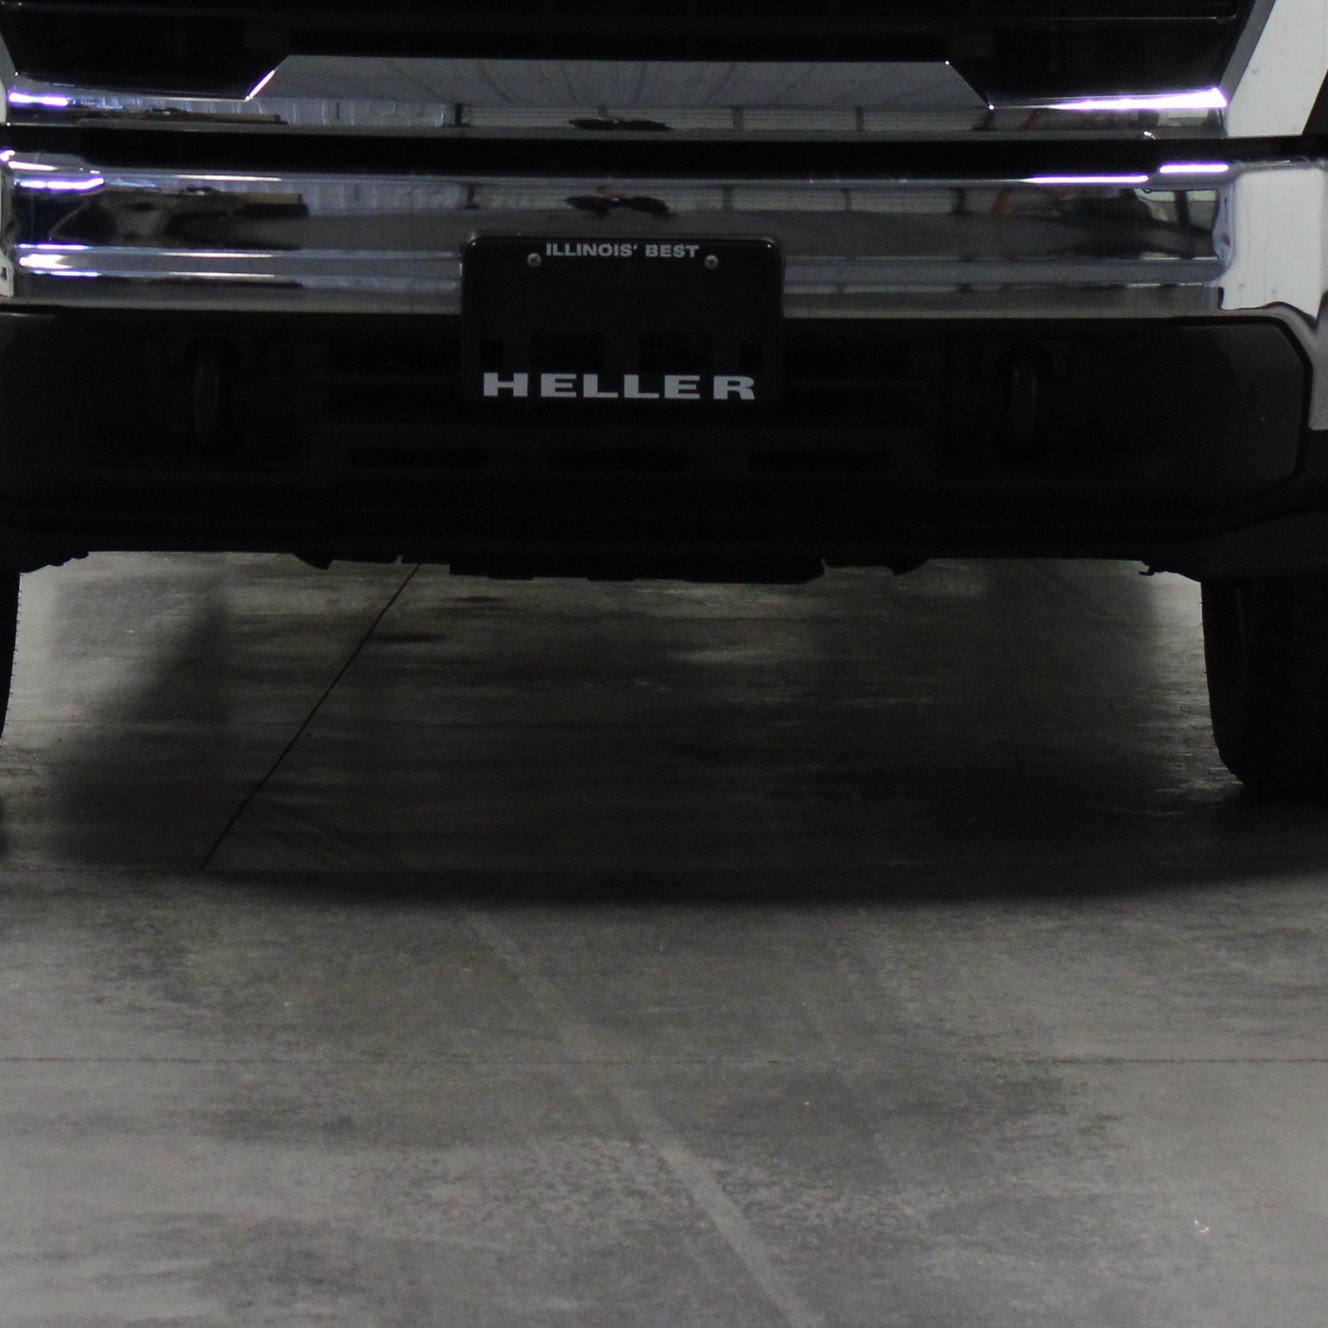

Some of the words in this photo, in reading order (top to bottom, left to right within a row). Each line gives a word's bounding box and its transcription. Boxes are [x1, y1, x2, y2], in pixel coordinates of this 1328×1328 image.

[546, 242, 638, 257] ILLINOIS'
[645, 243, 700, 258] BEST
[483, 372, 755, 400] HELLER
